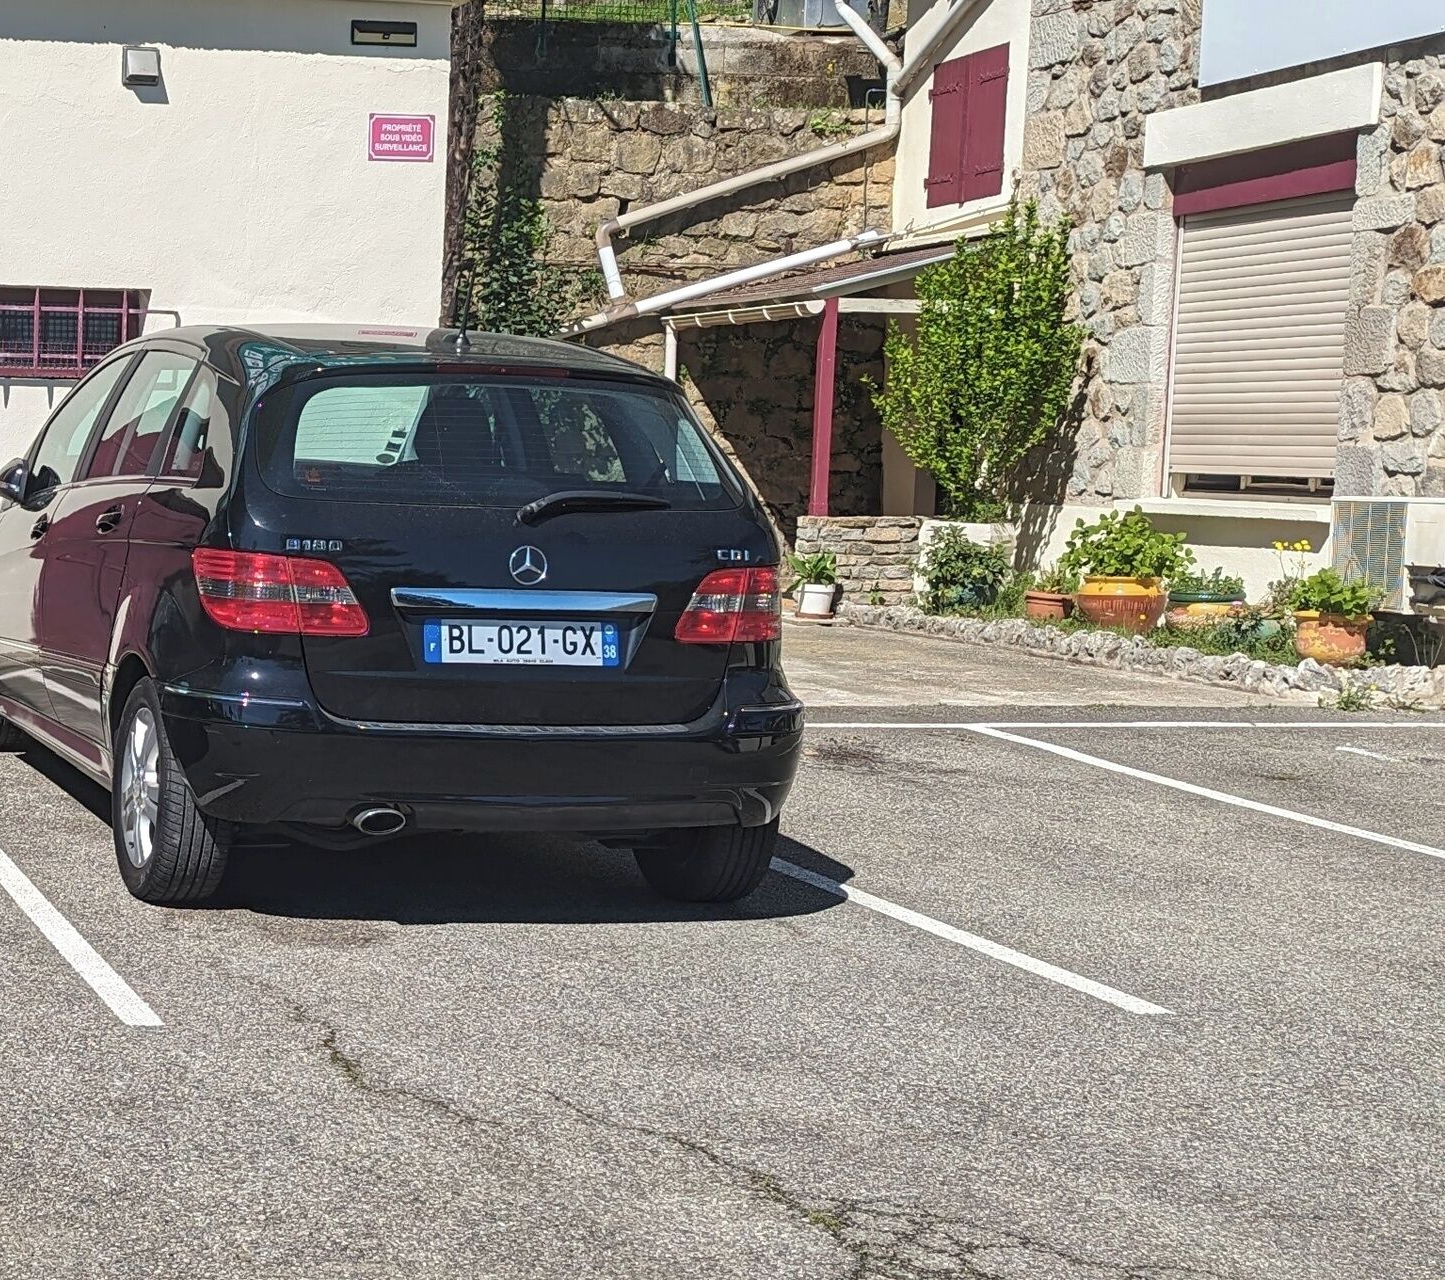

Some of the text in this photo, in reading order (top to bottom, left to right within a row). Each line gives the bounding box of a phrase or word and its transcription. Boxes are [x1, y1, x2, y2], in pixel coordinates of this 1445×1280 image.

[381, 122, 422, 133] PROPRIÉTÉ
[380, 132, 423, 142] SOUS VIDÉO
[374, 143, 428, 152] SURVEILLANCE
[717, 549, 750, 561] CDI
[429, 624, 617, 659] F BL-021-GX 38
